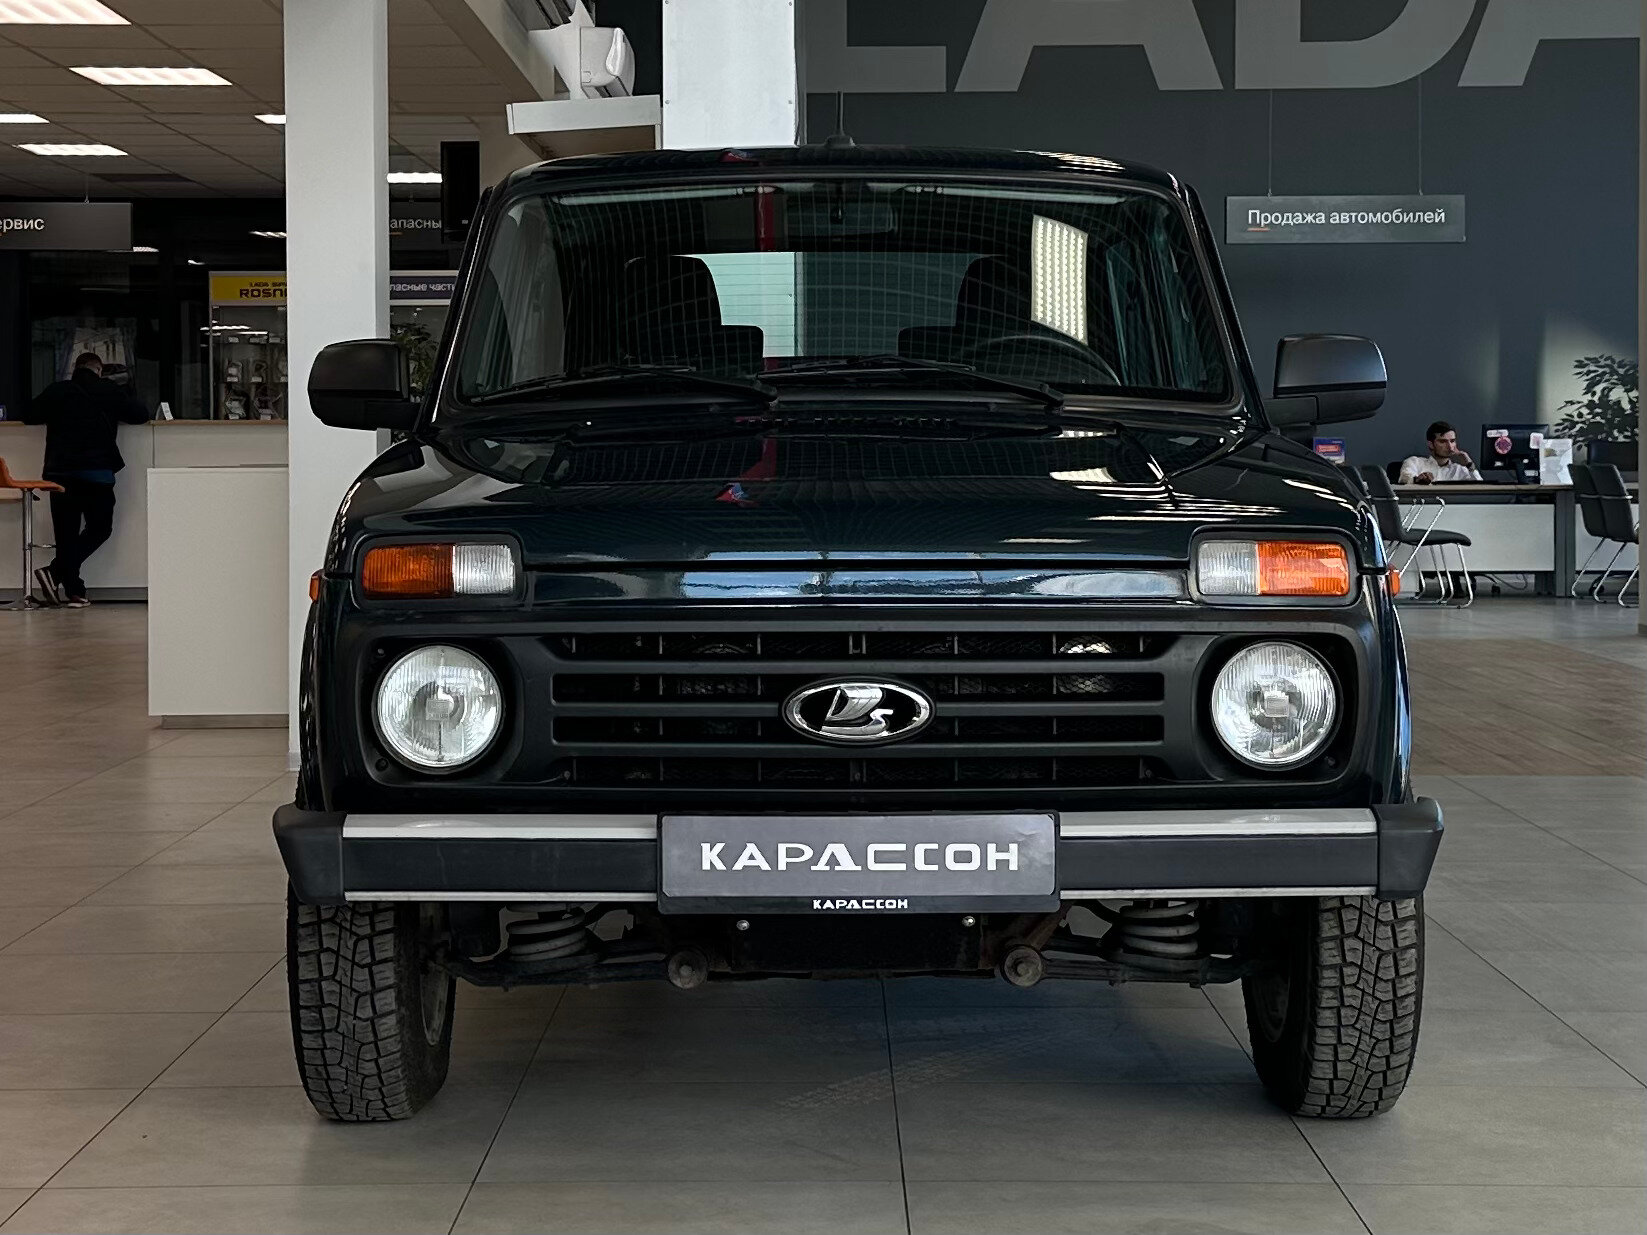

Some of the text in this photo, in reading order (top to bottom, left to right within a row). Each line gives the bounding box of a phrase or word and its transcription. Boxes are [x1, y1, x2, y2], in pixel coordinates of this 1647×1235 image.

[0, 218, 45, 233] рвис
[1248, 207, 1446, 227] Продажа автомобилей
[700, 842, 1019, 872] КАРАССОН
[812, 898, 908, 910] КАРАССОН
